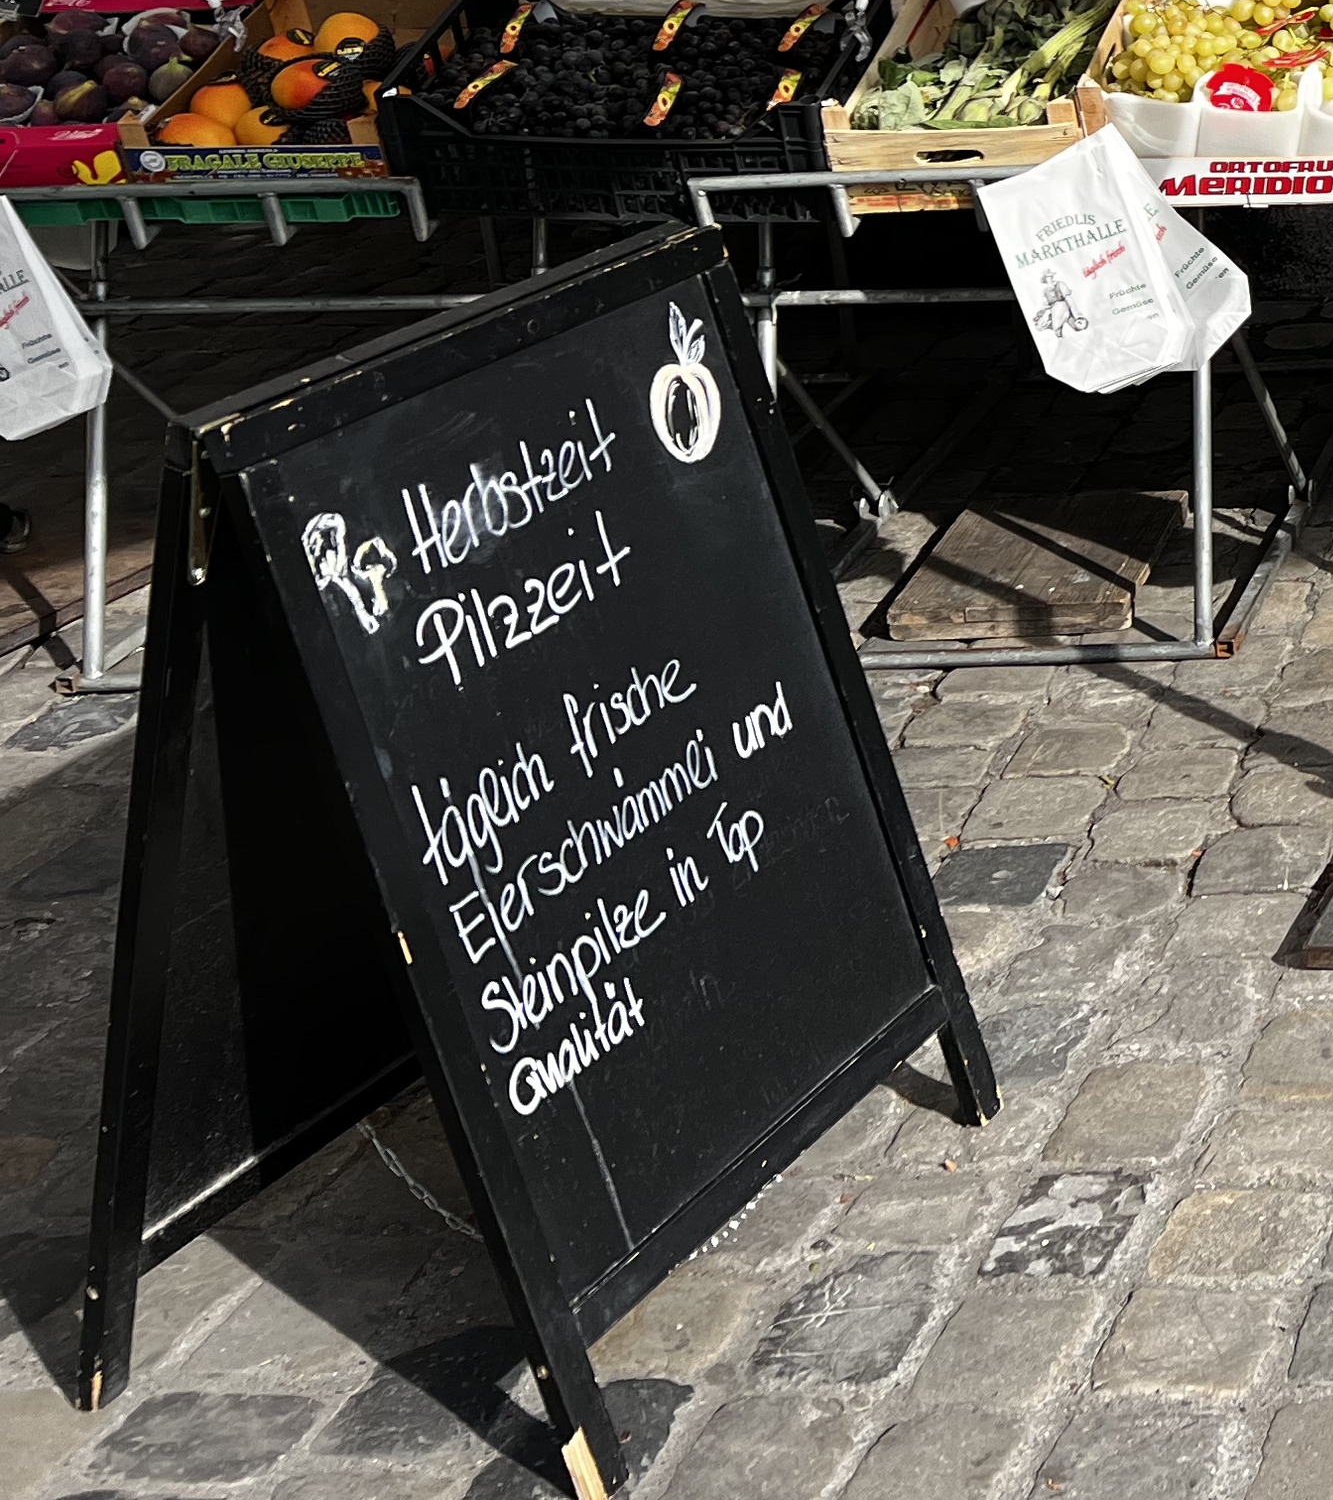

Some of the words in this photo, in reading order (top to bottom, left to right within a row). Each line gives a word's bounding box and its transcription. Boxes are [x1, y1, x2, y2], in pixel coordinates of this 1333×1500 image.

[1015, 218, 1127, 269] MARKTHALLE
[1035, 213, 1097, 243] FRIEDLIS
[1109, 282, 1148, 300] Früchte
[1174, 246, 1206, 280] Früchte
[1185, 255, 1219, 290] Gemüse
[1112, 297, 1155, 316] Gemüse
[401, 398, 617, 574] Herbstzeit
[415, 510, 632, 687] Pilzzeit
[732, 681, 793, 759] und
[411, 742, 554, 886] täglich
[563, 659, 697, 778] frische
[481, 889, 667, 1054] Steinpilze
[666, 847, 709, 908] in
[706, 801, 765, 873] Top
[508, 977, 646, 1116] Qualität
